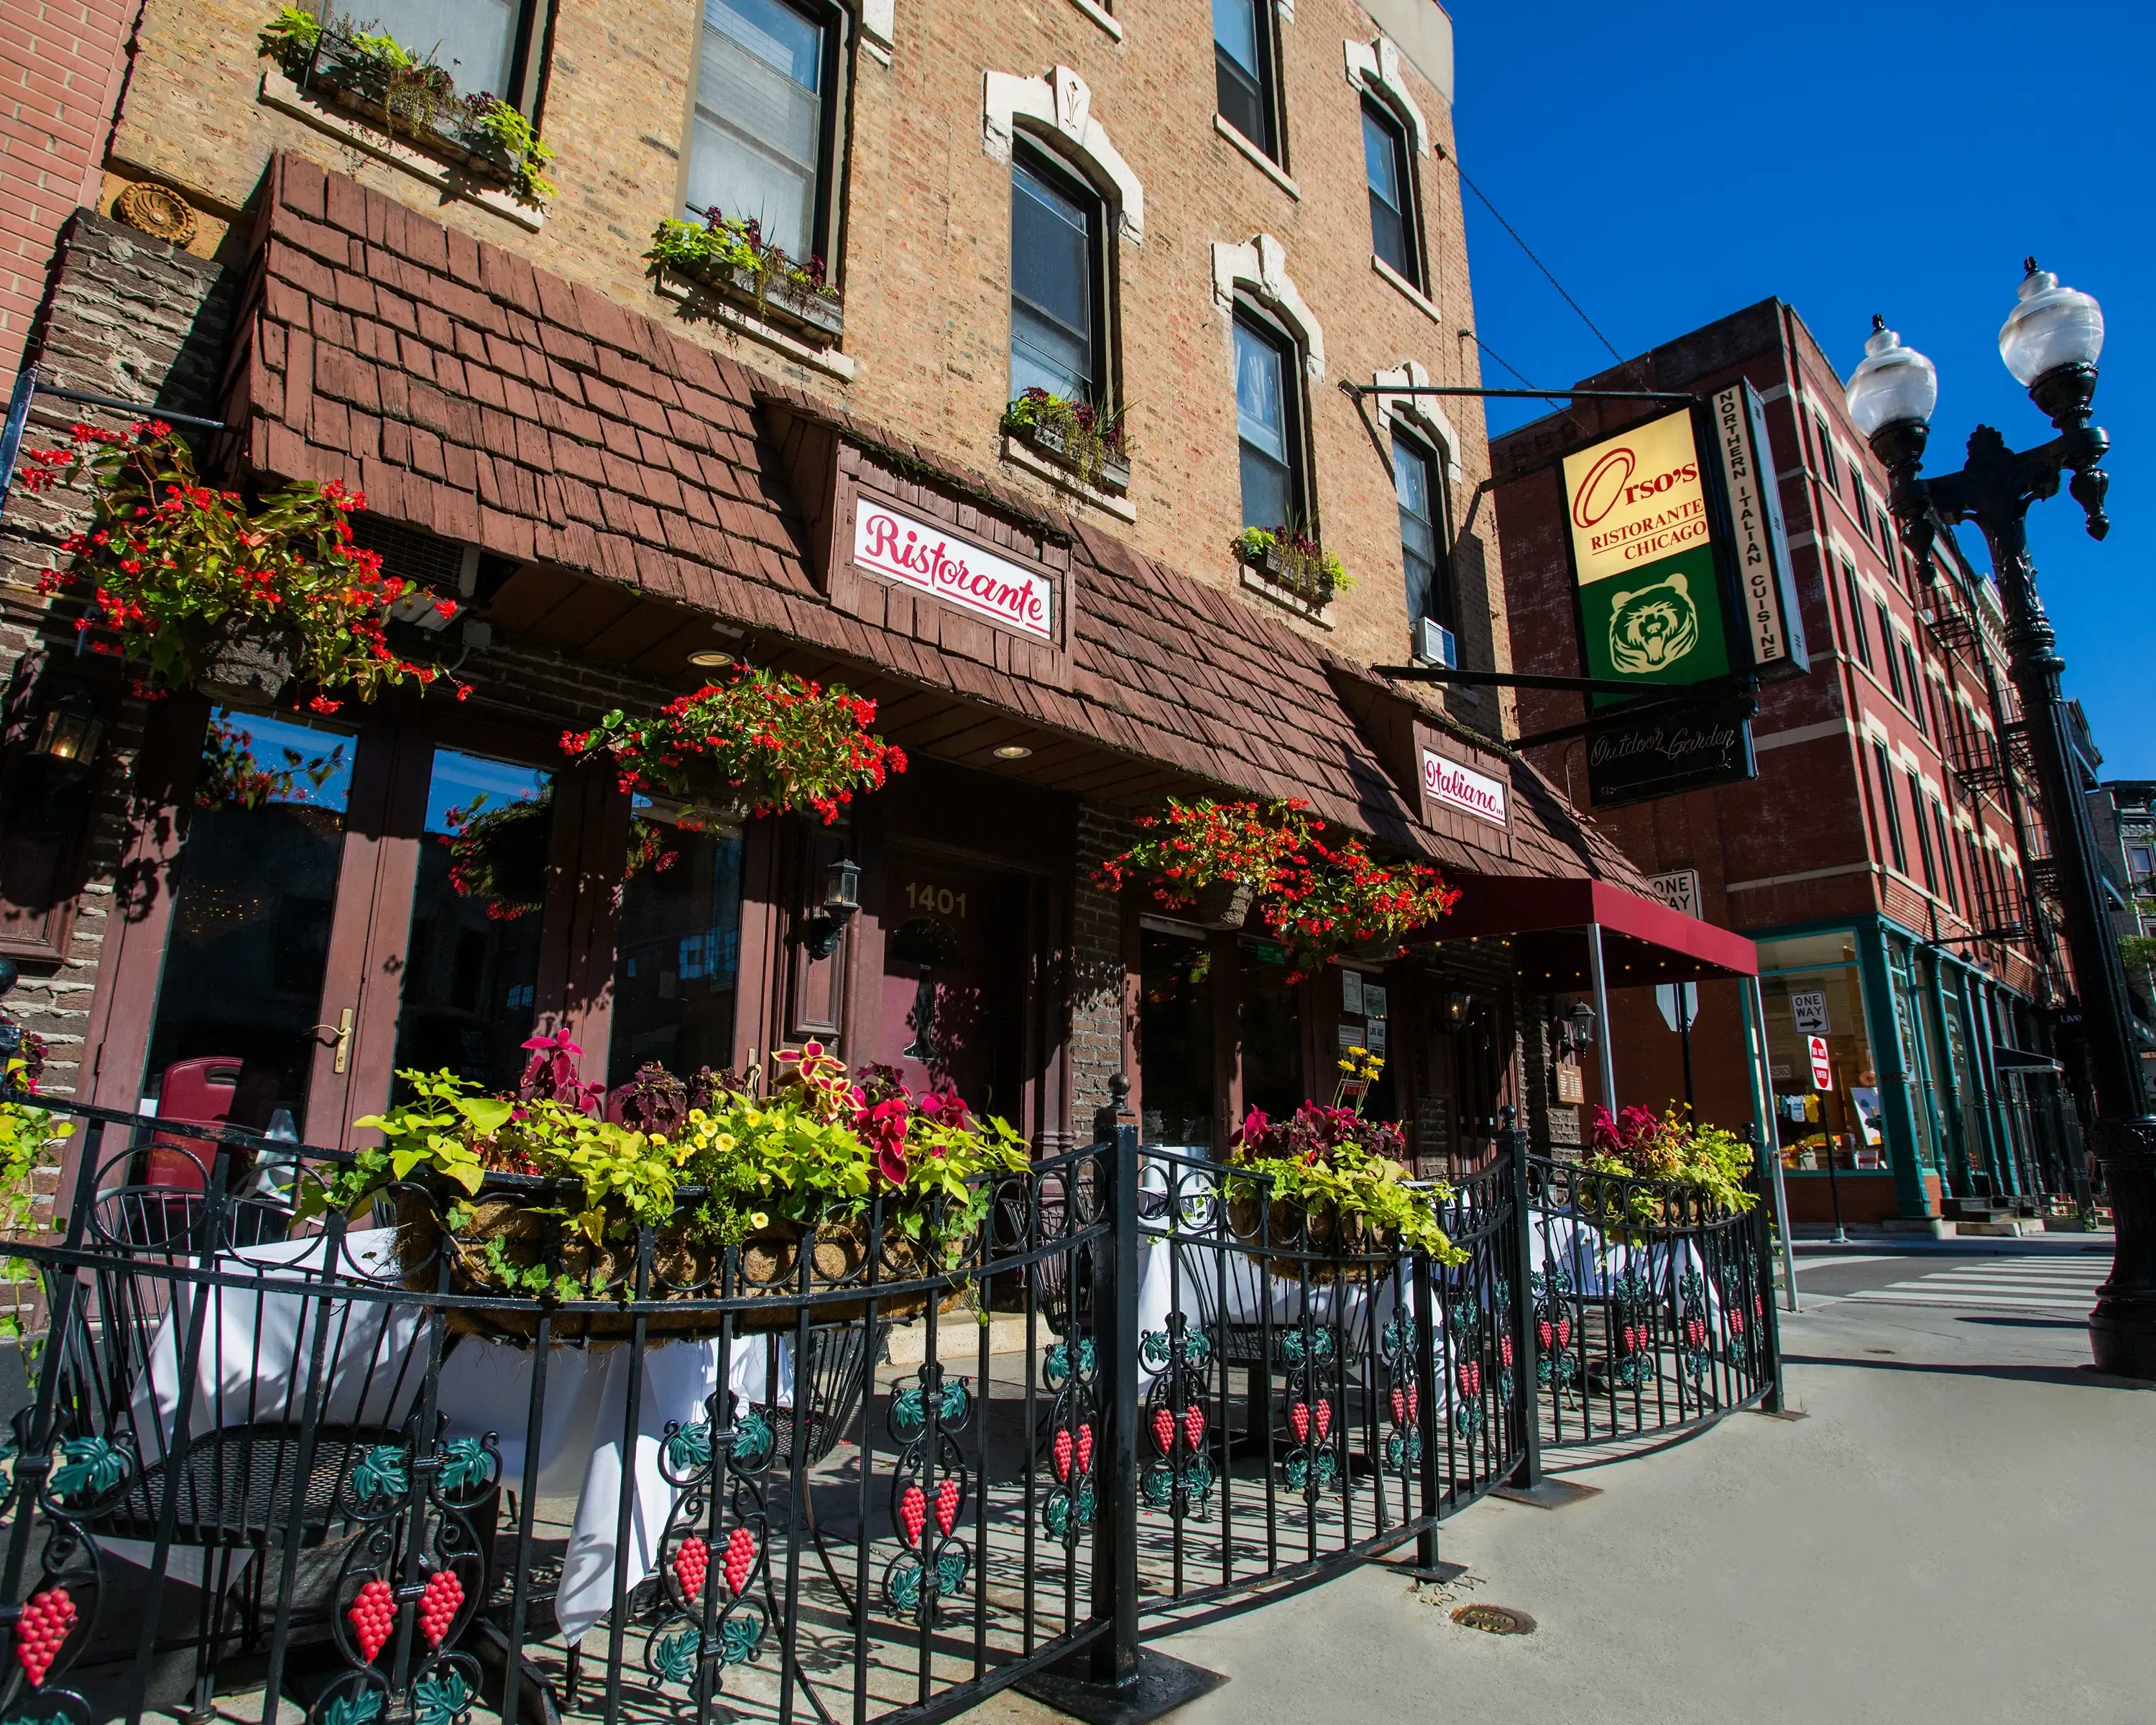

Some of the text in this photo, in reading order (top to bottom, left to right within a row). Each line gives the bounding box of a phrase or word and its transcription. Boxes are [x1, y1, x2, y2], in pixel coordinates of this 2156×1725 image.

[1590, 498, 1704, 551] RISTORANTE
[1624, 520, 1707, 560] CHICAGO
[1720, 390, 1777, 659] NORTHERN ITALIAN CUISINE
[865, 515, 1044, 623] Ristorante
[1590, 723, 1736, 767] Outdoor Garden
[906, 882, 966, 919] 1401
[1653, 876, 1689, 894] ONE
[1795, 995, 1820, 1006] ONE
[1796, 1006, 1822, 1018] WAY
[2060, 1014, 2082, 1024] Live
